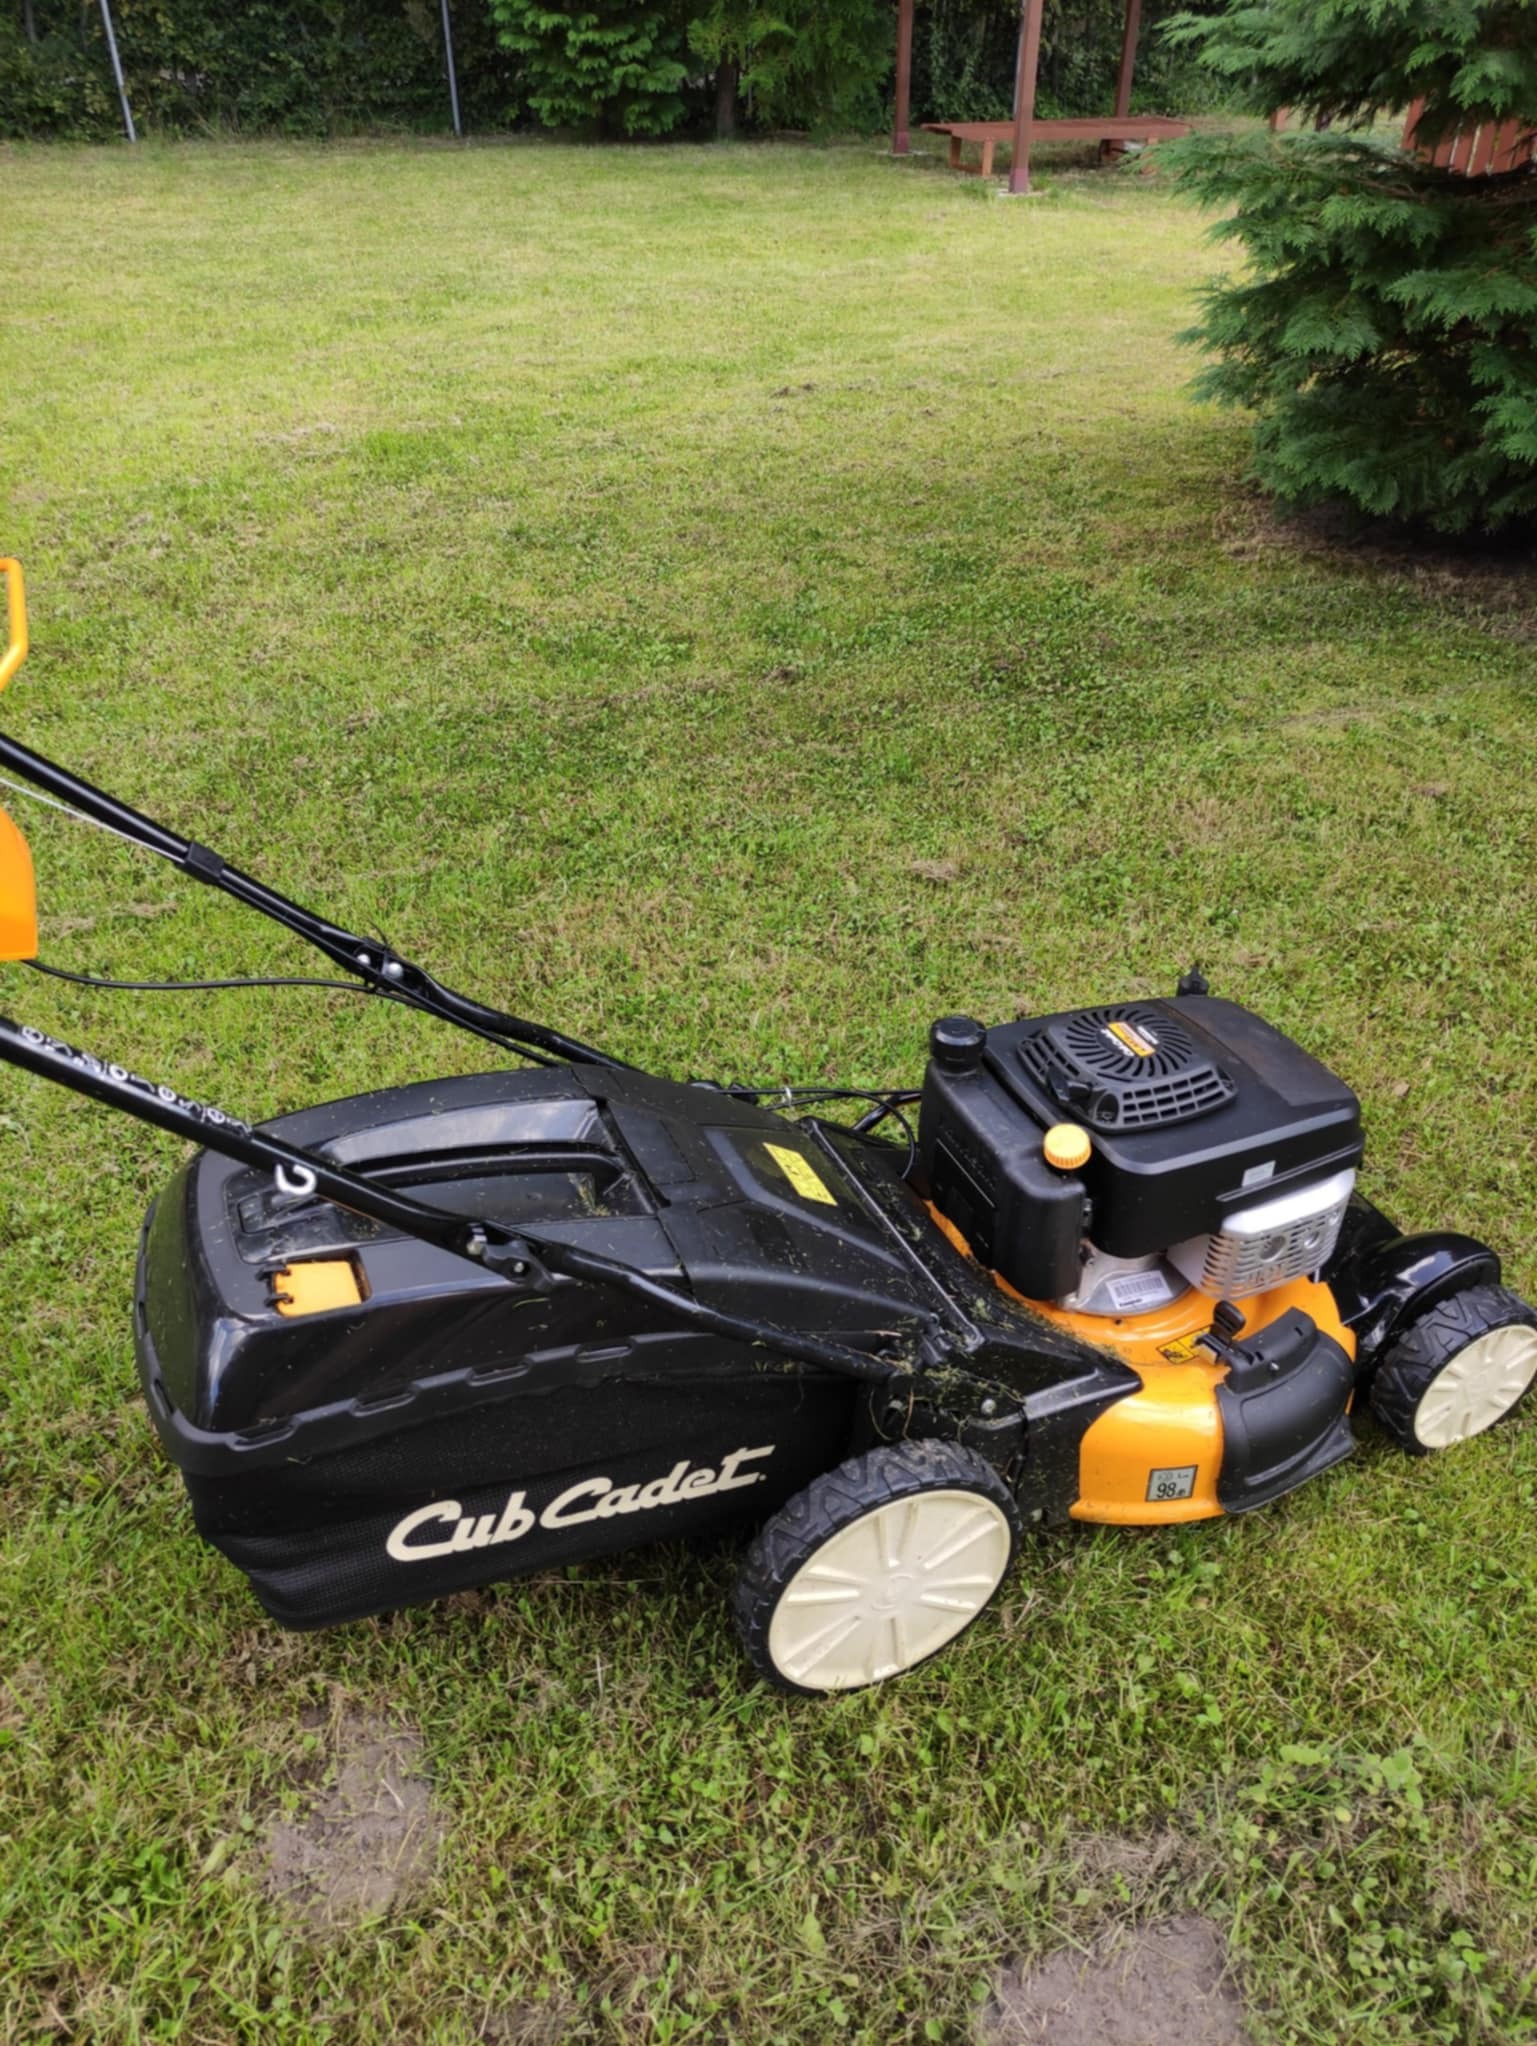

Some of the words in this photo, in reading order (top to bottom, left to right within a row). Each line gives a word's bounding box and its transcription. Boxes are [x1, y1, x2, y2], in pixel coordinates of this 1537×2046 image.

[385, 1490, 536, 1562] Cub
[539, 1444, 776, 1529] Cadet
[1156, 1482, 1177, 1498] 98
